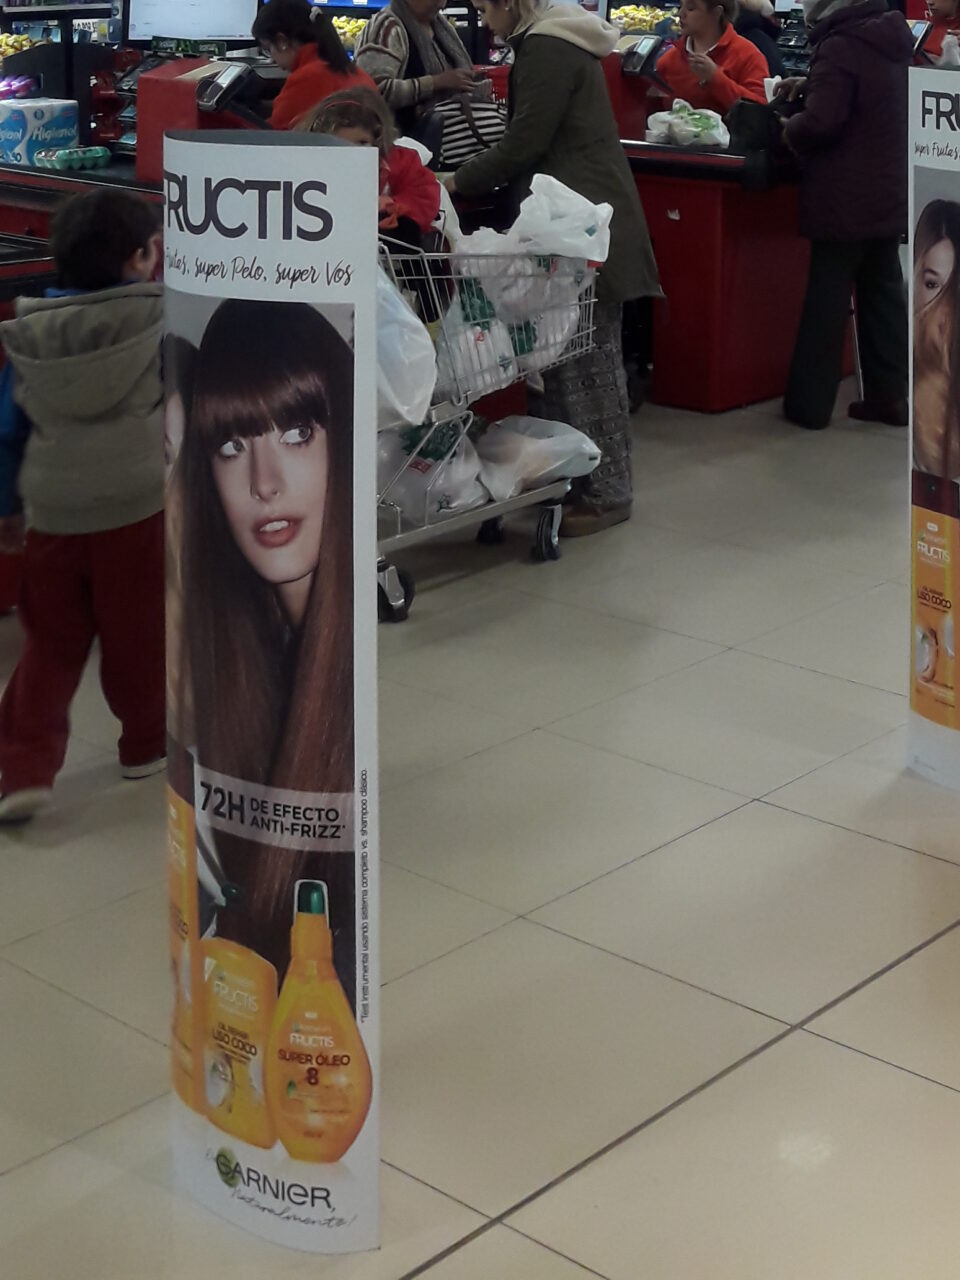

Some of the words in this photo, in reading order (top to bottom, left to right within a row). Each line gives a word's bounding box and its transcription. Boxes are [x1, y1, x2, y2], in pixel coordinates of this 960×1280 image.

[195, 256, 228, 283] super
[275, 263, 321, 289] super
[200, 781, 245, 825] 72H
[250, 799, 269, 814] DE
[273, 803, 339, 823] EFECTO
[360, 799, 369, 837] shampoo
[278, 1048, 313, 1065] SUPER
[306, 1067, 318, 1086] 8
